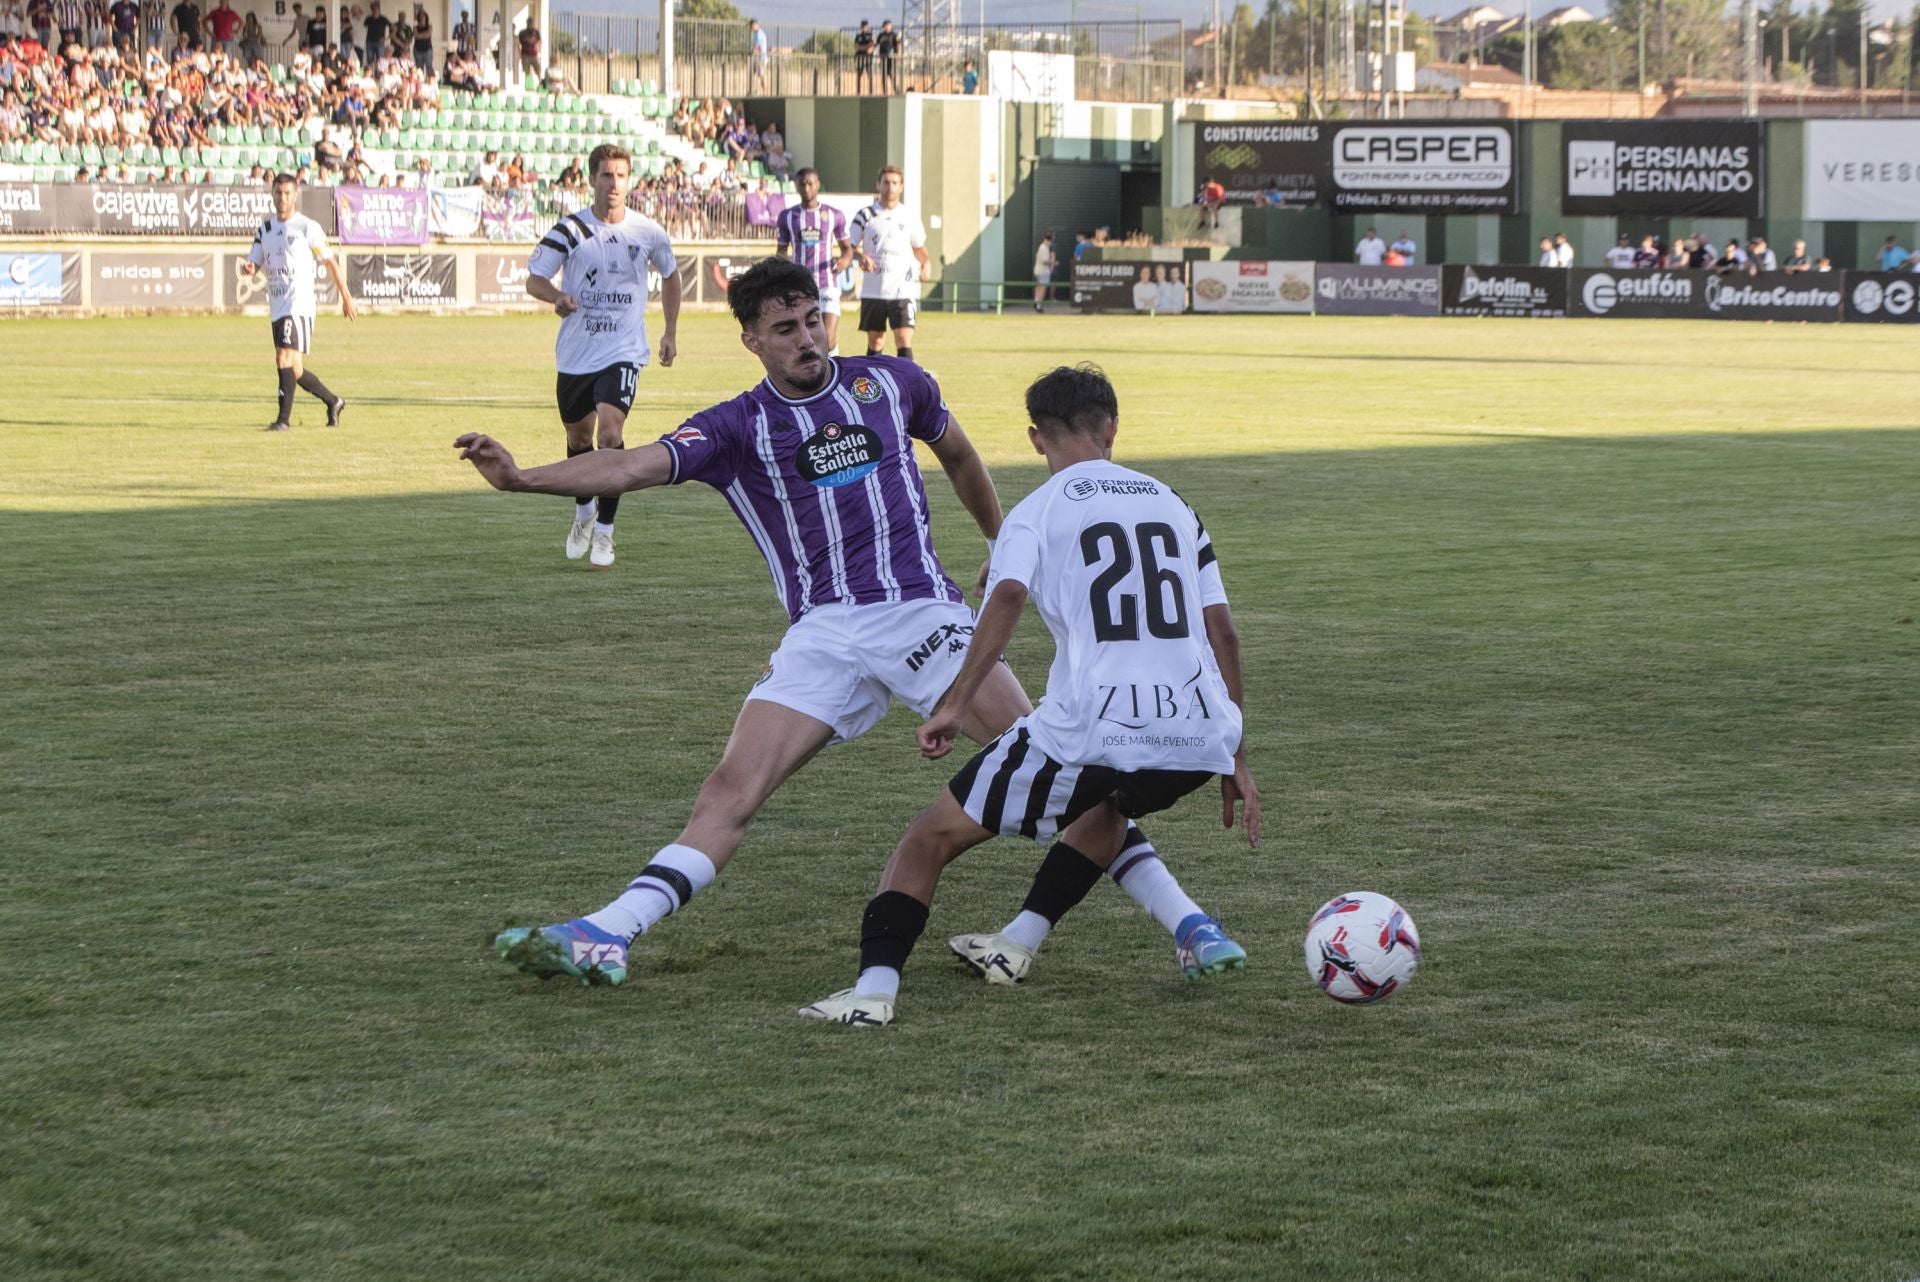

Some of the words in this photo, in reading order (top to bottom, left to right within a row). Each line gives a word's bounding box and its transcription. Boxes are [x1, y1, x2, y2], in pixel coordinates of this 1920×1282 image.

[1204, 126, 1319, 141] CONSTRUCCIONES
[1343, 136, 1499, 162] CASPER
[1616, 146, 1750, 168] PERSIANAS
[1616, 169, 1754, 192] HERNANDO
[1823, 161, 1920, 183] VERES
[132, 213, 179, 229] Segovia
[100, 265, 163, 279] aridos
[169, 265, 205, 279] siro
[1075, 265, 1101, 277] TIEMPO
[1102, 265, 1111, 277] DE
[1112, 265, 1135, 278] JUEGO
[1342, 277, 1438, 292] ALUMINIOS
[1617, 272, 1692, 297] eufón
[1719, 285, 1841, 307] BricoCentro
[620, 366, 637, 396] 14
[808, 433, 868, 460] Estrella
[813, 448, 870, 475] Galicia
[1097, 479, 1155, 488] OCTAVIANO
[1101, 485, 1160, 496] PALOMO
[1080, 521, 1190, 644] 26
[1102, 733, 1127, 748] JOSÉ
[1129, 733, 1161, 746] MARÍA
[1163, 735, 1206, 748] EVENTOS
